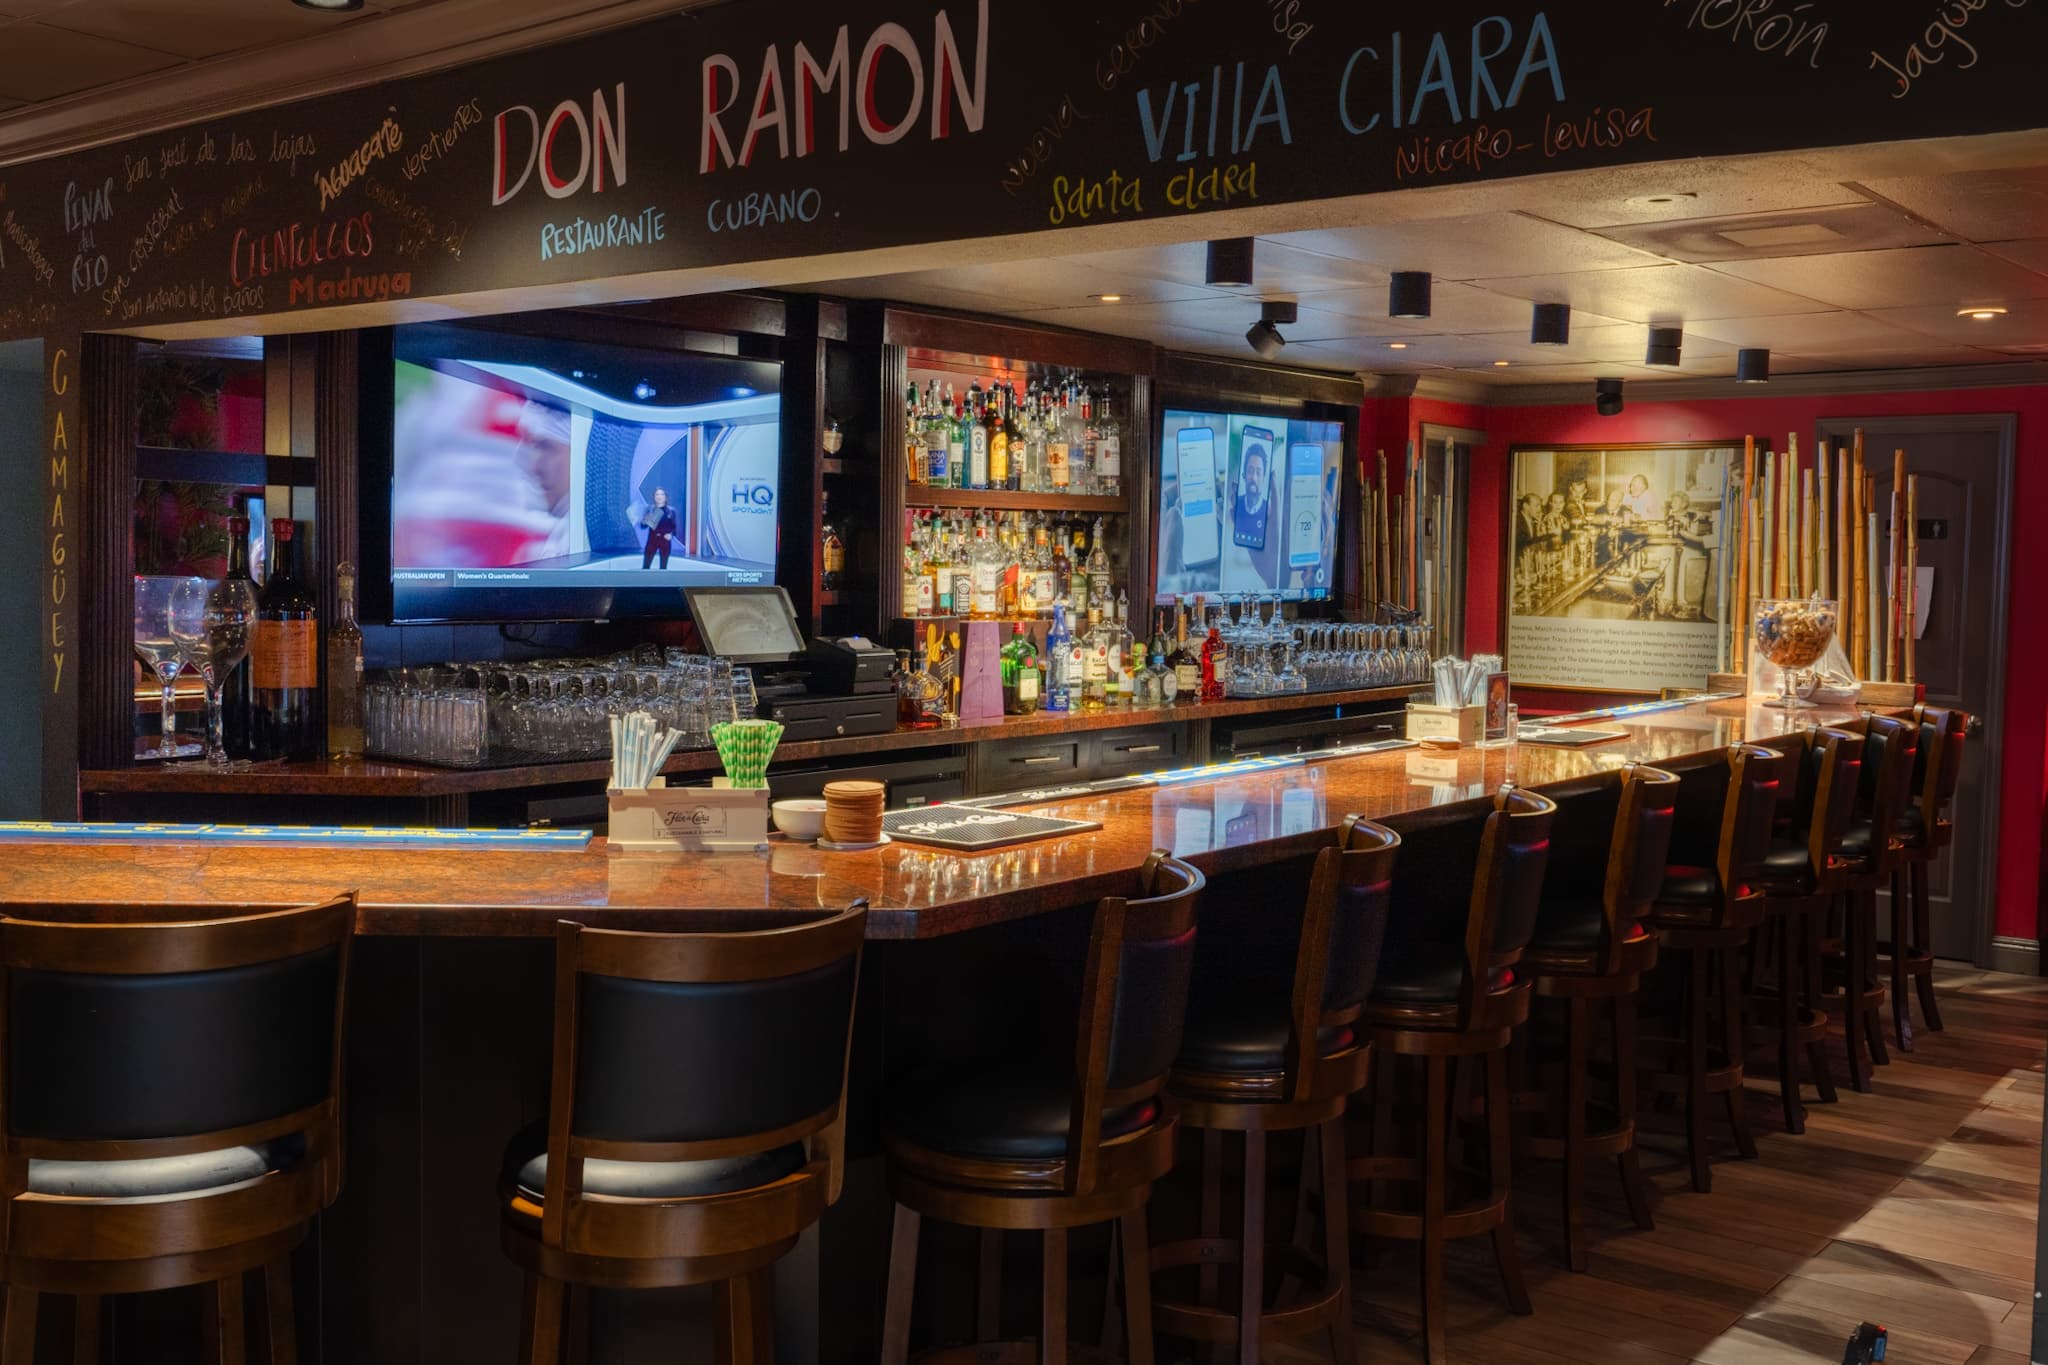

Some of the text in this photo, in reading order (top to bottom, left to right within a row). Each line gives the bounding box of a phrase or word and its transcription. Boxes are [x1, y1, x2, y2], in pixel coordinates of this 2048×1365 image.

[491, 0, 990, 207] DON RAMON
[195, 131, 218, 166] de
[1048, 169, 1144, 222] Santa
[540, 205, 666, 262] RESTAURANTE
[289, 266, 413, 306] Madruga
[732, 483, 774, 506] HQ
[50, 348, 69, 695] CAMAGÜEY
[1299, 521, 1312, 532] 720
[393, 572, 446, 580] AUSTRALIAN OPEN
[457, 572, 487, 580] Women's
